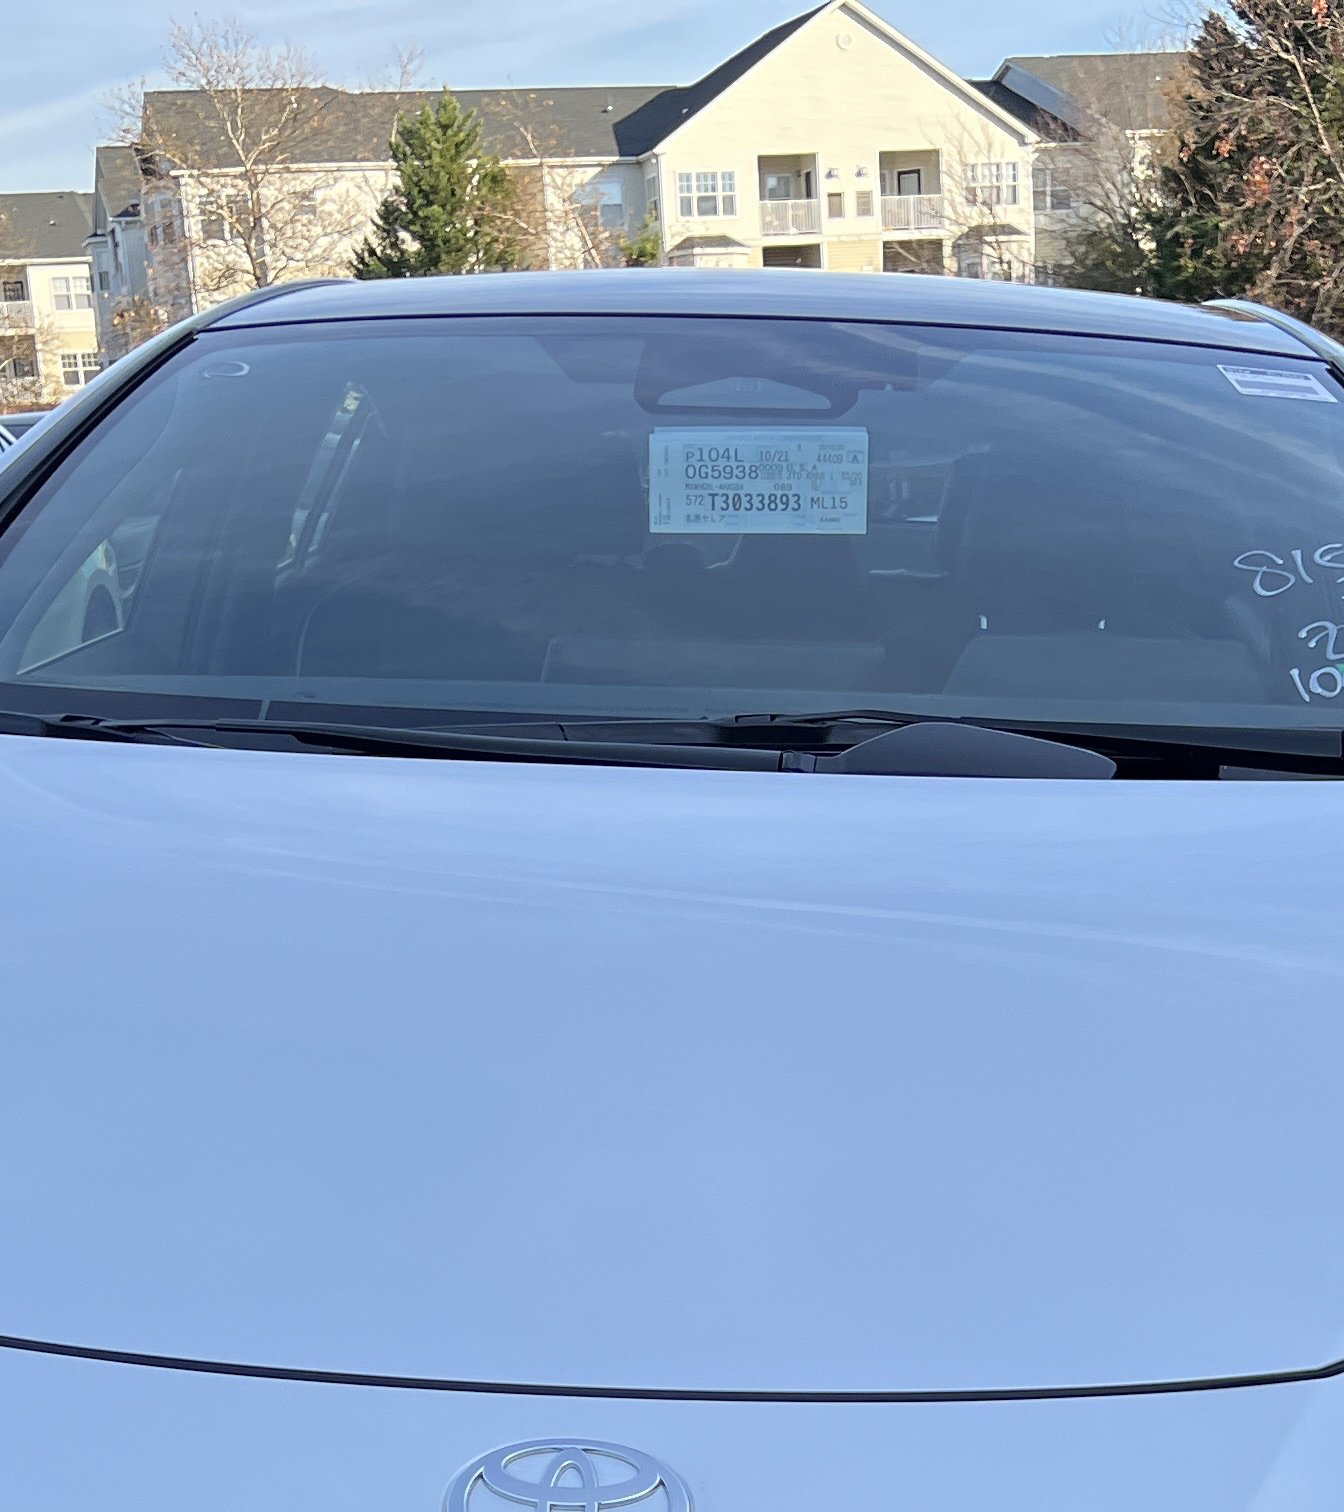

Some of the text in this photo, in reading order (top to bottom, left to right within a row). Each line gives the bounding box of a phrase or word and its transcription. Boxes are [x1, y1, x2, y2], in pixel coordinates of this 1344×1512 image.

[758, 449, 789, 464] 10/21
[685, 492, 848, 512] 572 T3033893 ML15
